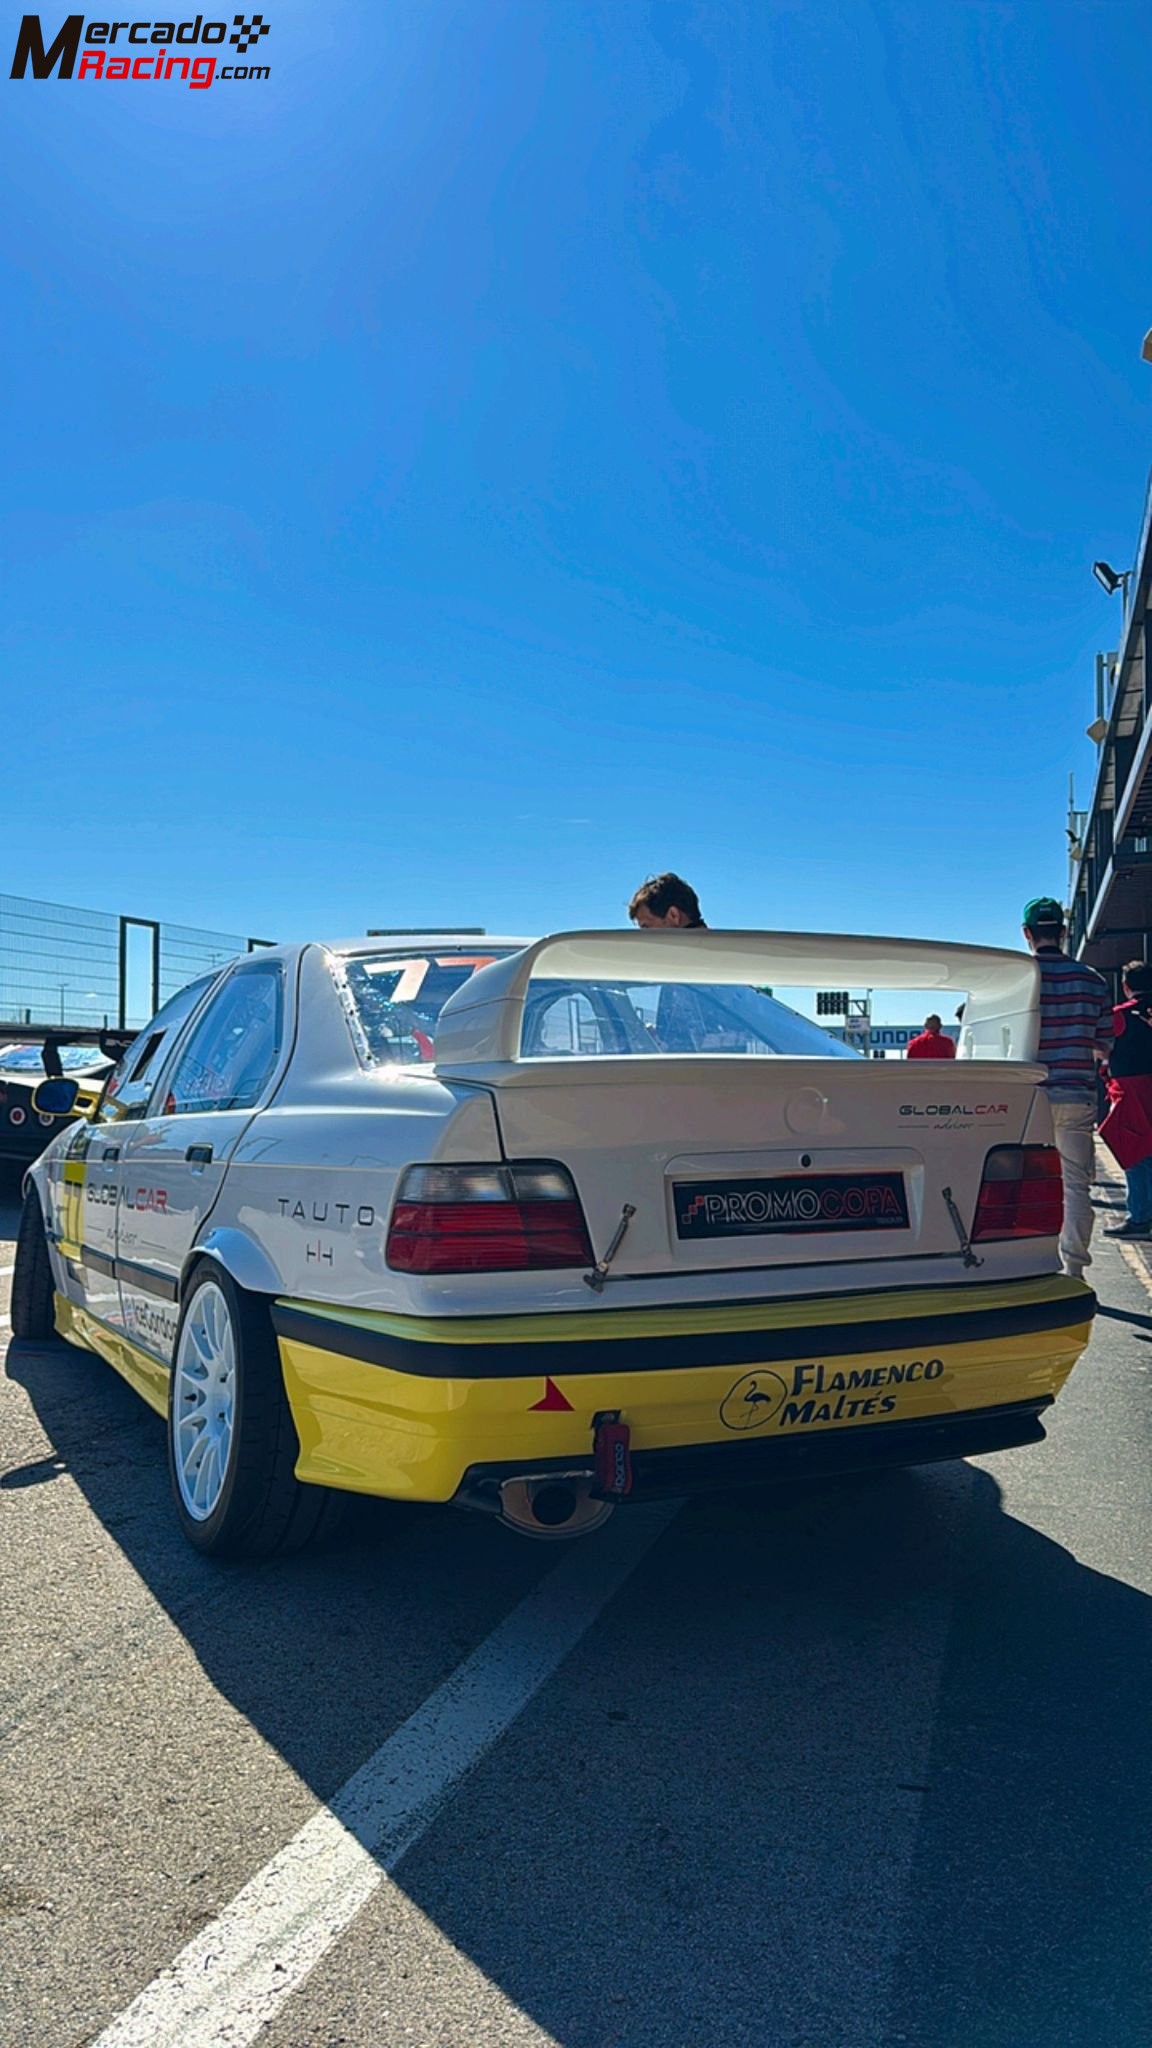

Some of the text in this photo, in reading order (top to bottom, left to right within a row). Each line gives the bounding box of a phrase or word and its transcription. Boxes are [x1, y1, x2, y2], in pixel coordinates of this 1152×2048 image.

[843, 1030, 922, 1044] HYUNDA
[898, 1104, 1008, 1116] GLOBALCAR
[277, 1198, 375, 1226] TAUTO
[705, 1186, 901, 1224] PROMOCOPA
